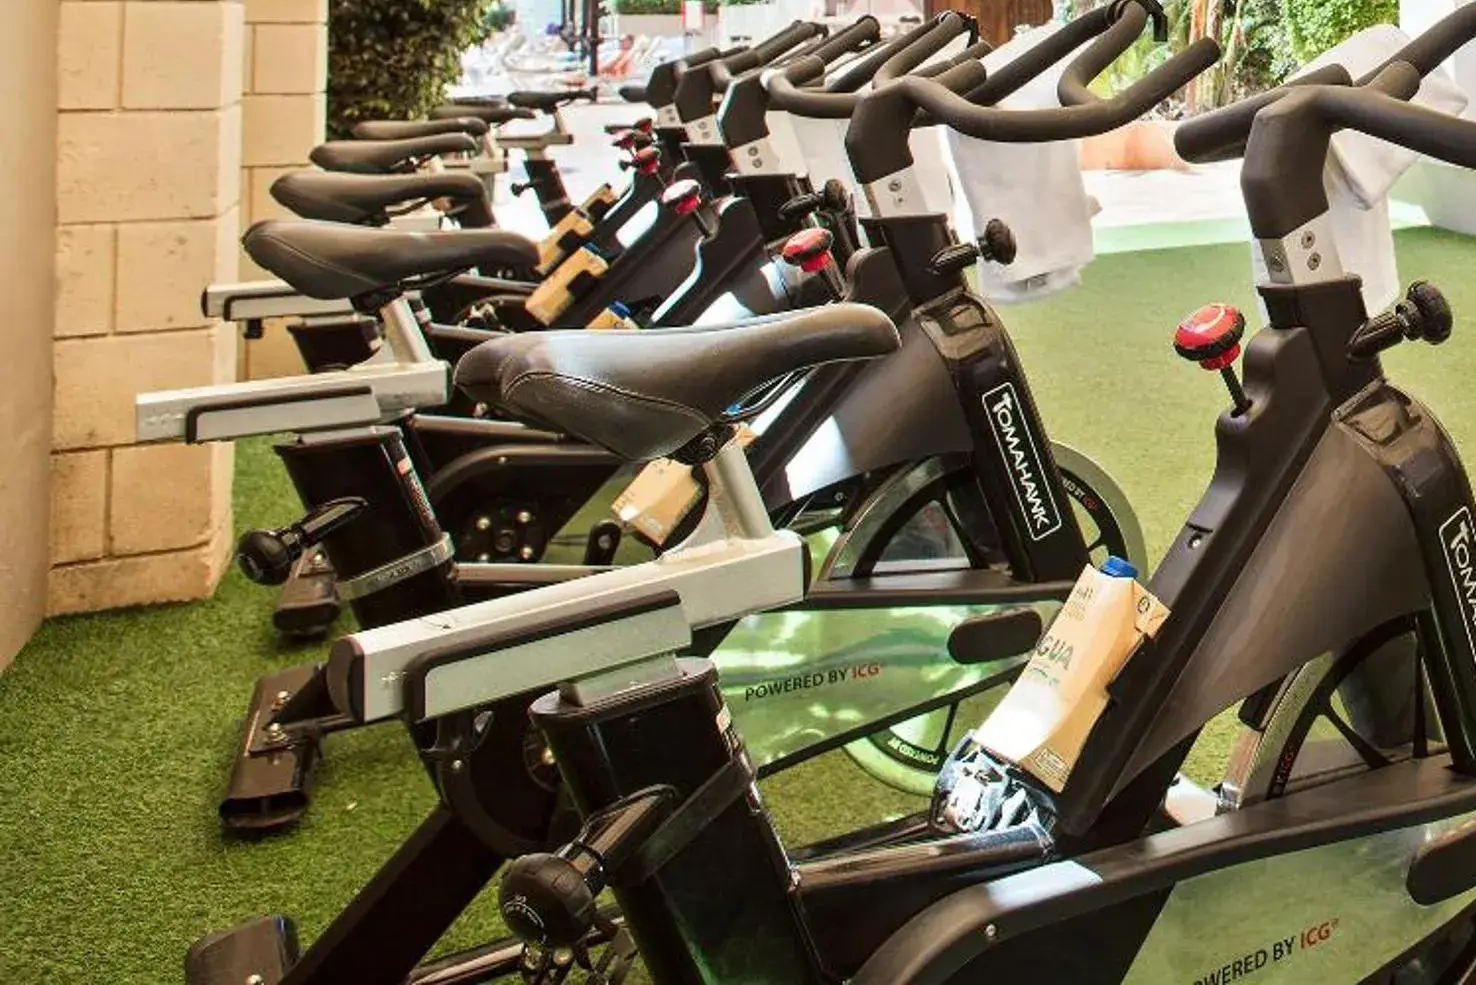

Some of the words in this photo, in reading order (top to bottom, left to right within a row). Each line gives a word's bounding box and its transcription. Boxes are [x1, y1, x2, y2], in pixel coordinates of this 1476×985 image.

[992, 392, 1050, 529] TOMAHAWK
[745, 673, 824, 701] POWERED
[828, 668, 848, 685] BY
[1273, 935, 1296, 961] BY
